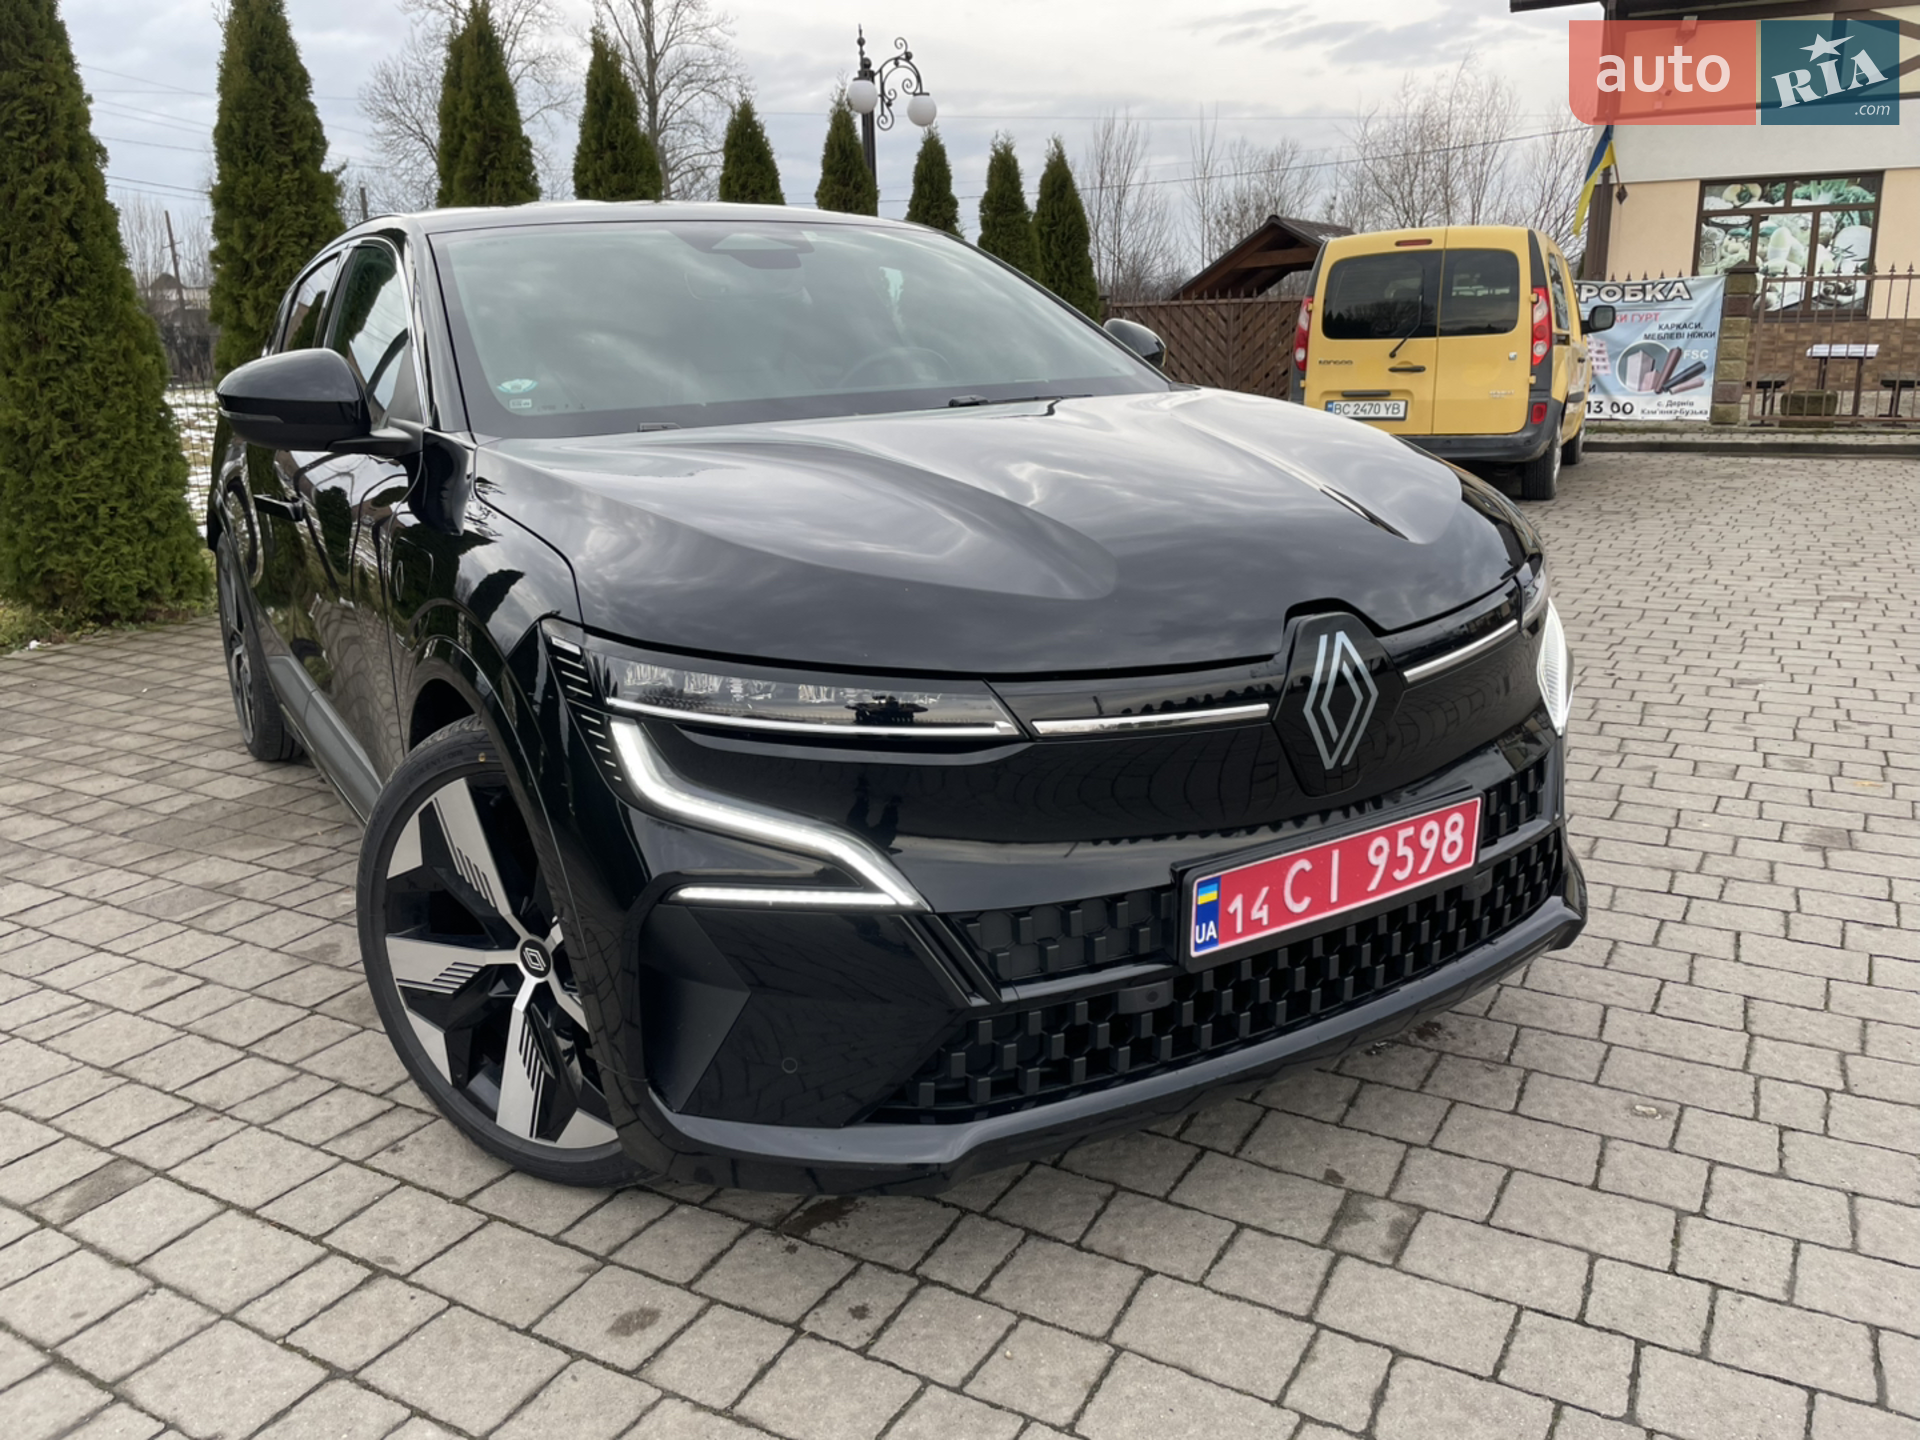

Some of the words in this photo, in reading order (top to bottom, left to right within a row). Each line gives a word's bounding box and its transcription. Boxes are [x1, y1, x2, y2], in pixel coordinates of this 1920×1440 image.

[1631, 312, 1660, 323] ГУРТ
[1683, 349, 1709, 360] FSC
[1334, 403, 1351, 416] BC
[1353, 403, 1380, 416] 2470
[1227, 887, 1270, 934] 14
[1367, 812, 1465, 893] 9598
[1195, 920, 1218, 944] UA
